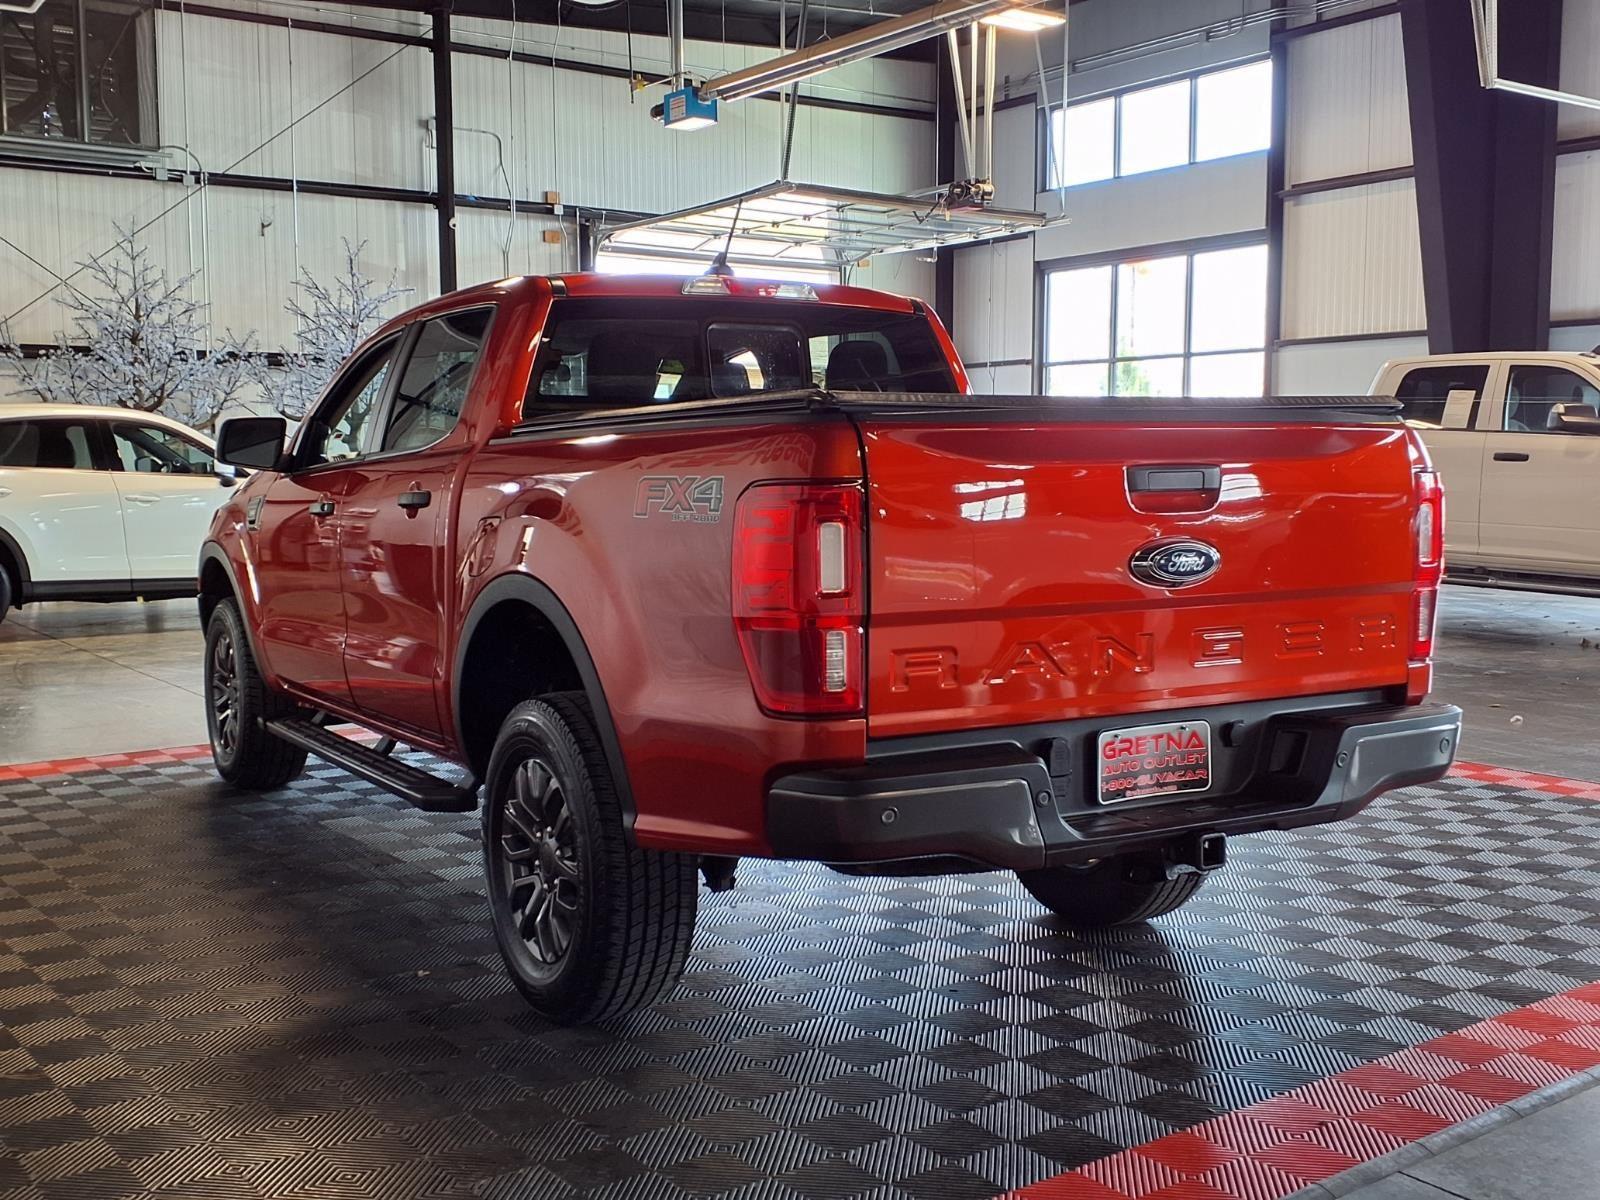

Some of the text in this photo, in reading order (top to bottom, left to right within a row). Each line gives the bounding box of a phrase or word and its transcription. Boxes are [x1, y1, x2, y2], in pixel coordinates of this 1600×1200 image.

[633, 475, 725, 518] FX4
[1168, 551, 1206, 572] Ford
[889, 613, 1396, 693] RANGER
[1103, 729, 1206, 760] GRETNA
[1102, 752, 1207, 776] AUTO OUTLET
